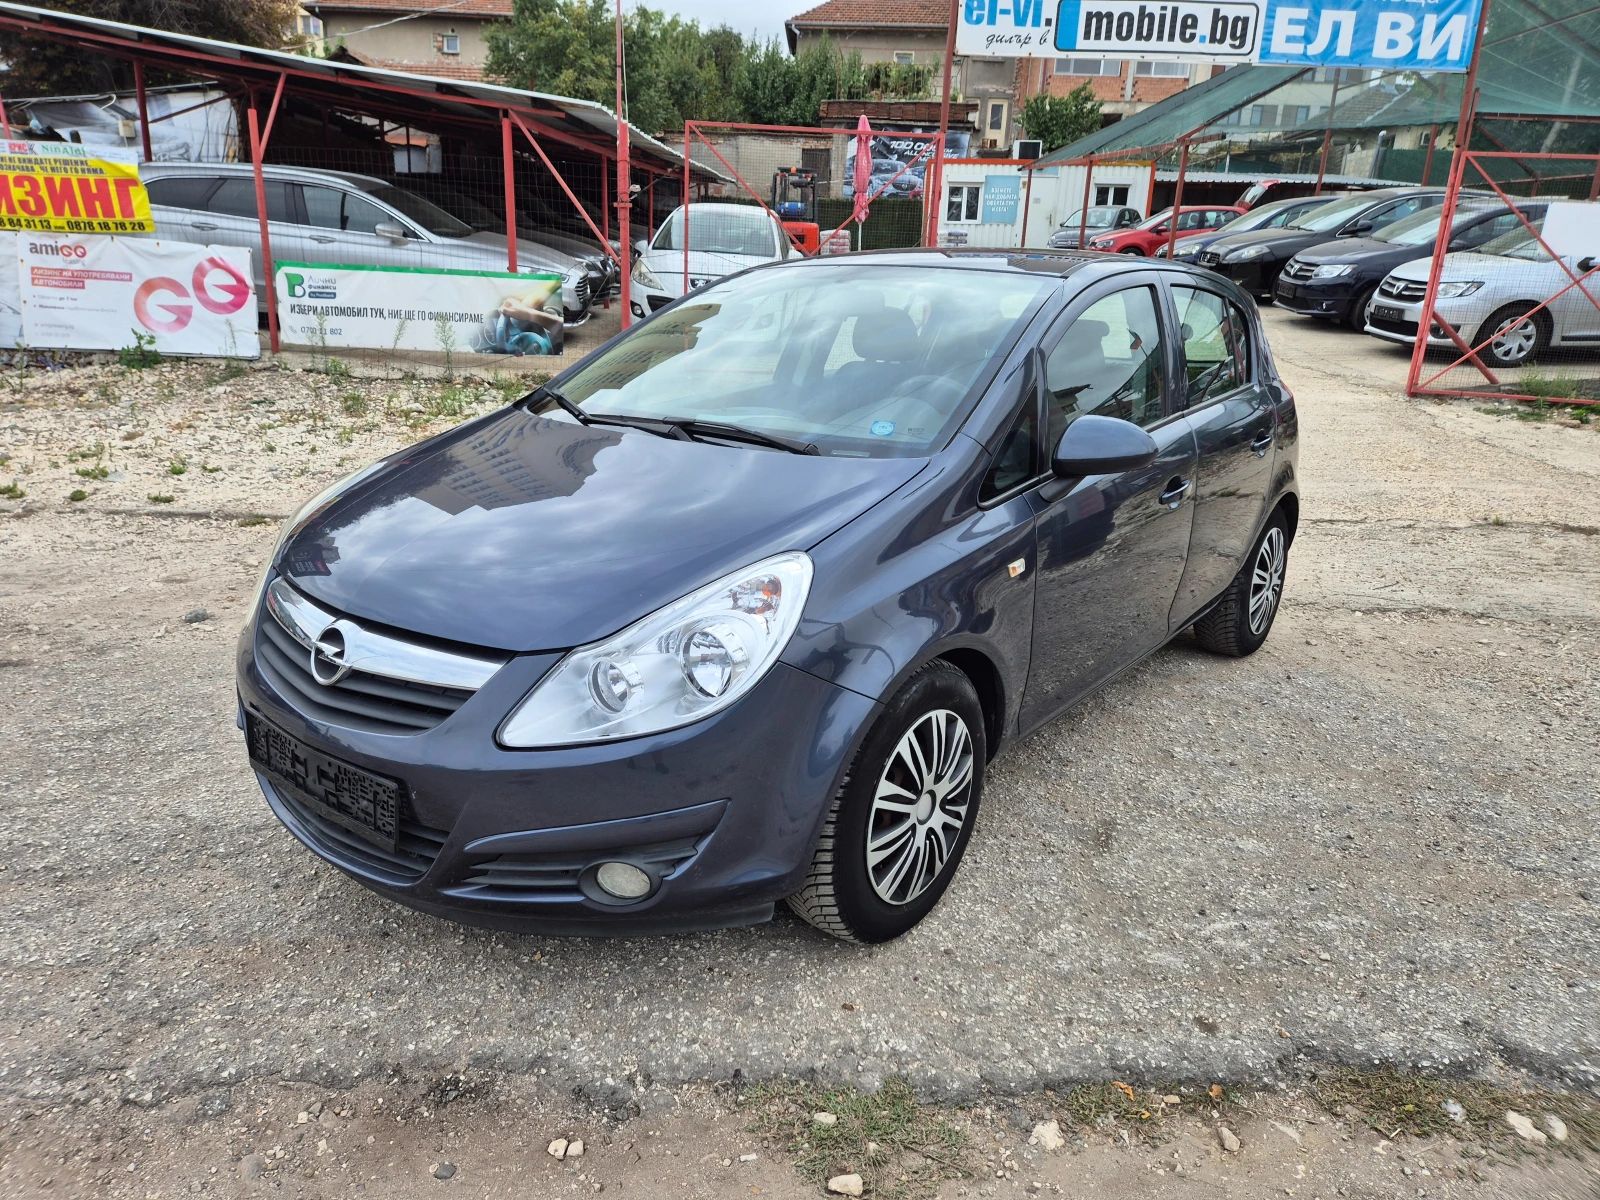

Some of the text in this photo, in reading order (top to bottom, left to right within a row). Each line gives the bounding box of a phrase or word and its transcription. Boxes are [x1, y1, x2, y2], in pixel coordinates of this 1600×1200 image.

[1083, 6, 1251, 50] mobile.bg
[1270, 7, 1468, 61] ЕЛ ВИ
[986, 30, 1051, 49] дилър в
[18, 157, 52, 165] ВИЖДАТЕ
[51, 166, 69, 174] НЕГО
[7, 218, 23, 228] 84
[24, 218, 37, 229] 31
[38, 219, 51, 229] 13
[66, 220, 95, 231] 0878
[97, 221, 112, 231] 18
[114, 222, 127, 231] 78
[129, 222, 146, 231] 28
[32, 268, 131, 281] ЛИЗИНГ НА УПОТРЕБЯВАНИ
[307, 275, 336, 285] Лични
[33, 278, 83, 288] АВТОМОБИЛИ
[290, 303, 484, 324] ИЗБЕРИ АВТОМОБИЛ ТУК, НИЕ ЩЕ ГО ФИНАНСИРАМЕ
